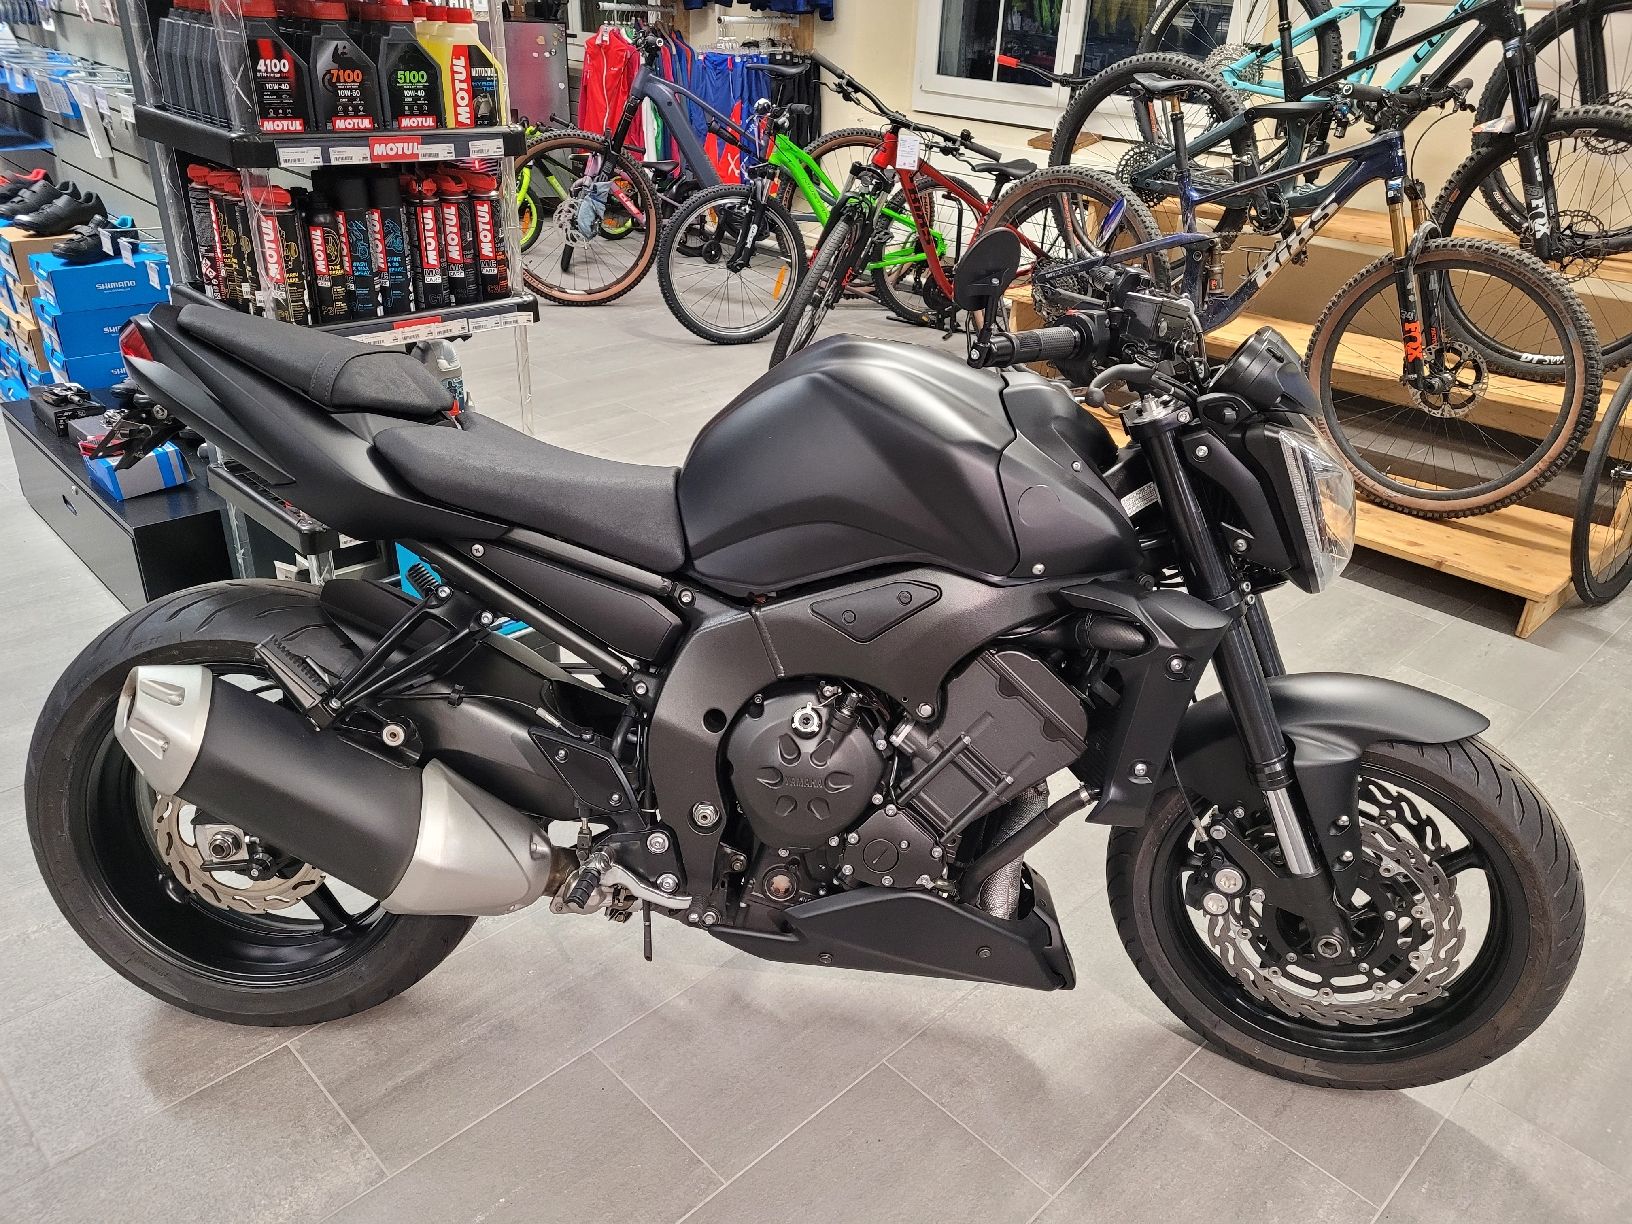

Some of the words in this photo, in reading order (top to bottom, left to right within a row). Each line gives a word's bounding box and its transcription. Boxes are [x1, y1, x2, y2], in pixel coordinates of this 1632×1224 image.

[256, 59, 290, 73] 4100
[330, 69, 362, 83] 7100
[397, 70, 428, 83] 5100
[452, 56, 471, 125] MOTUL
[263, 120, 303, 131] MOTUL
[335, 118, 372, 129] MOTUL
[401, 117, 435, 128] MOTUL
[373, 142, 420, 156] MOTUL
[1528, 196, 1551, 239] FOX
[421, 209, 438, 265] MOTUL
[444, 206, 462, 261] MOTUL
[476, 203, 494, 258] MOTUL
[371, 211, 386, 270] MOTUL
[261, 219, 282, 281] MOTUL
[311, 229, 327, 273] MOTUL
[480, 260, 497, 268] MC
[95, 280, 136, 290] SHIMANO
[1403, 320, 1424, 363] FOX
[1520, 352, 1543, 364] DT
[784, 775, 823, 788] YAMAHA
